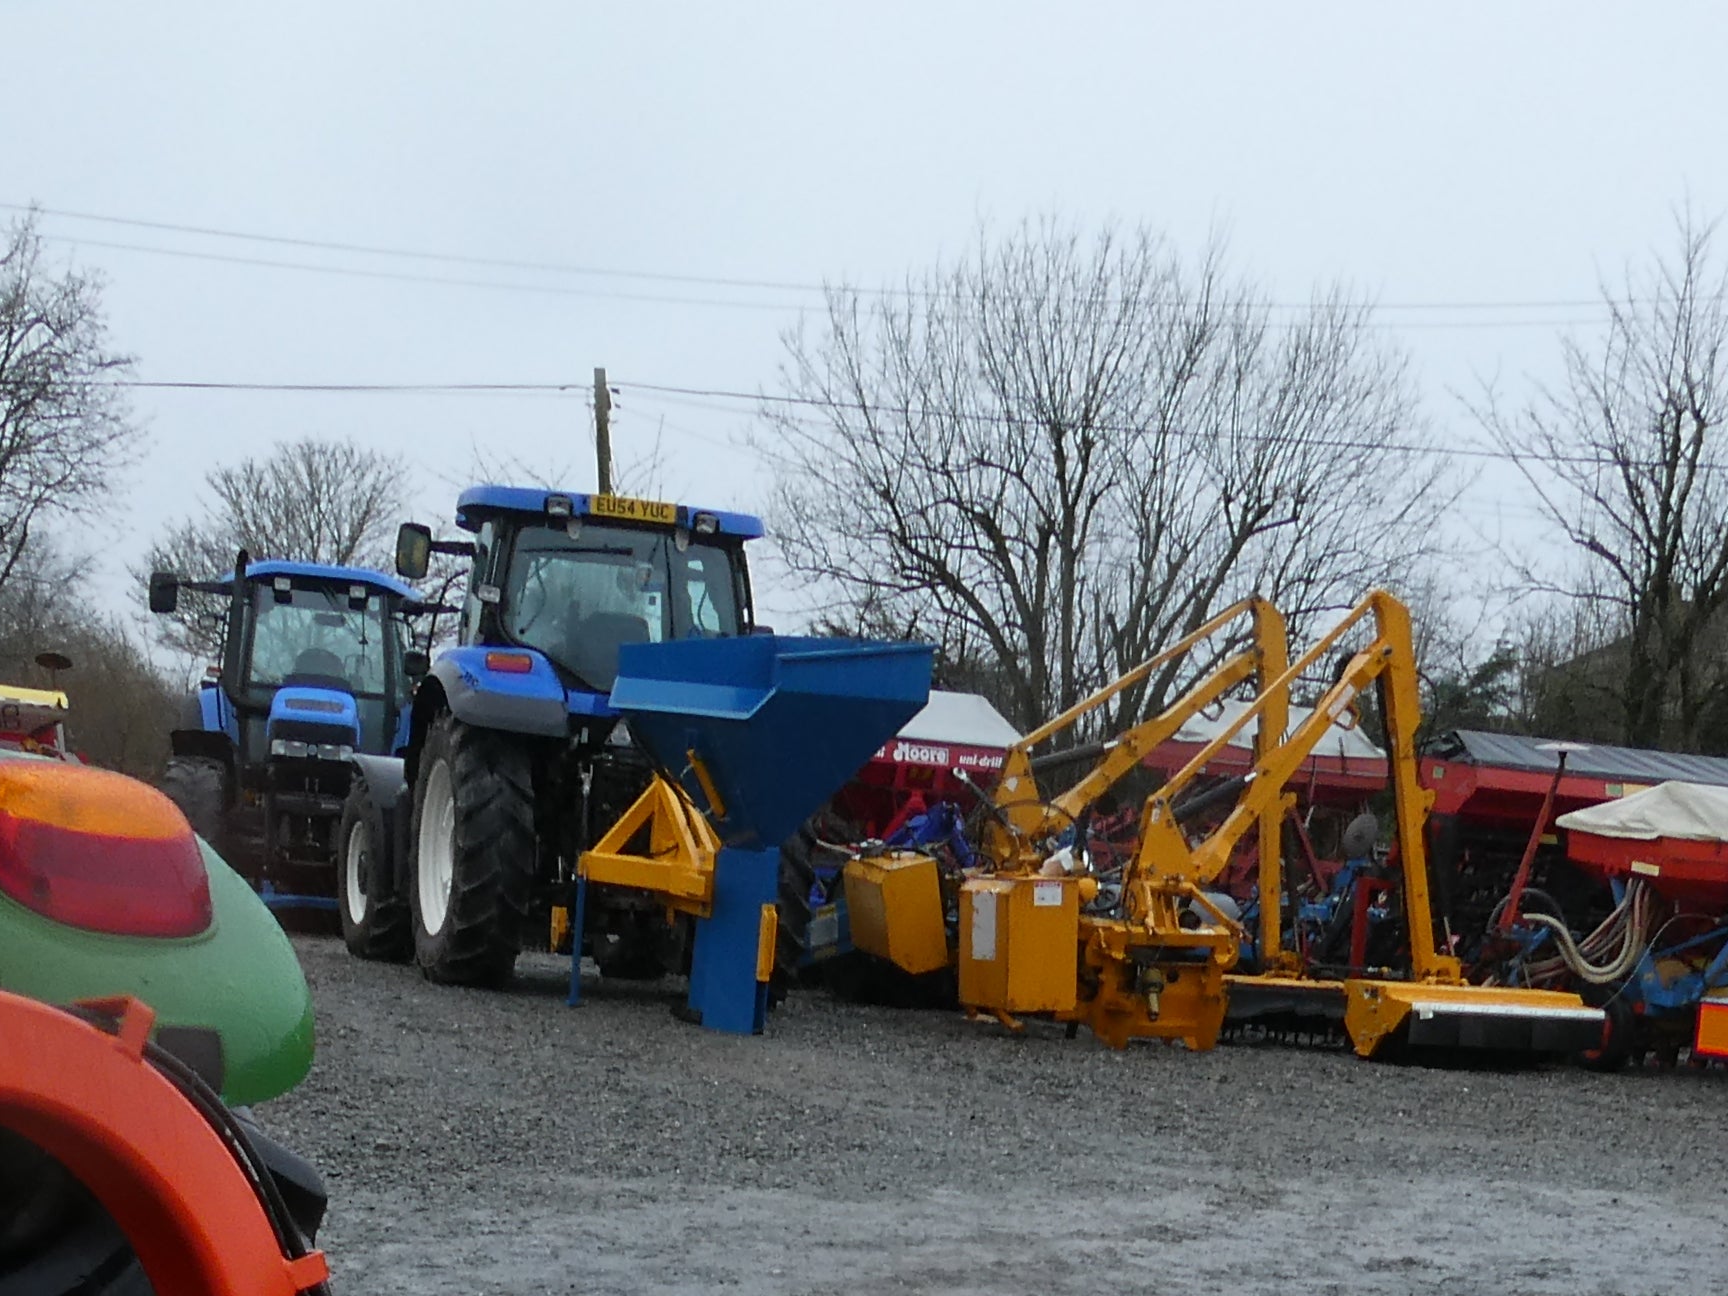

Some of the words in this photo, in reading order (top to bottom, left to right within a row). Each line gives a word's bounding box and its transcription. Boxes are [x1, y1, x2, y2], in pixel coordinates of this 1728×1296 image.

[597, 497, 635, 515] EU54
[641, 501, 669, 519] YUC
[893, 742, 947, 764] Moore
